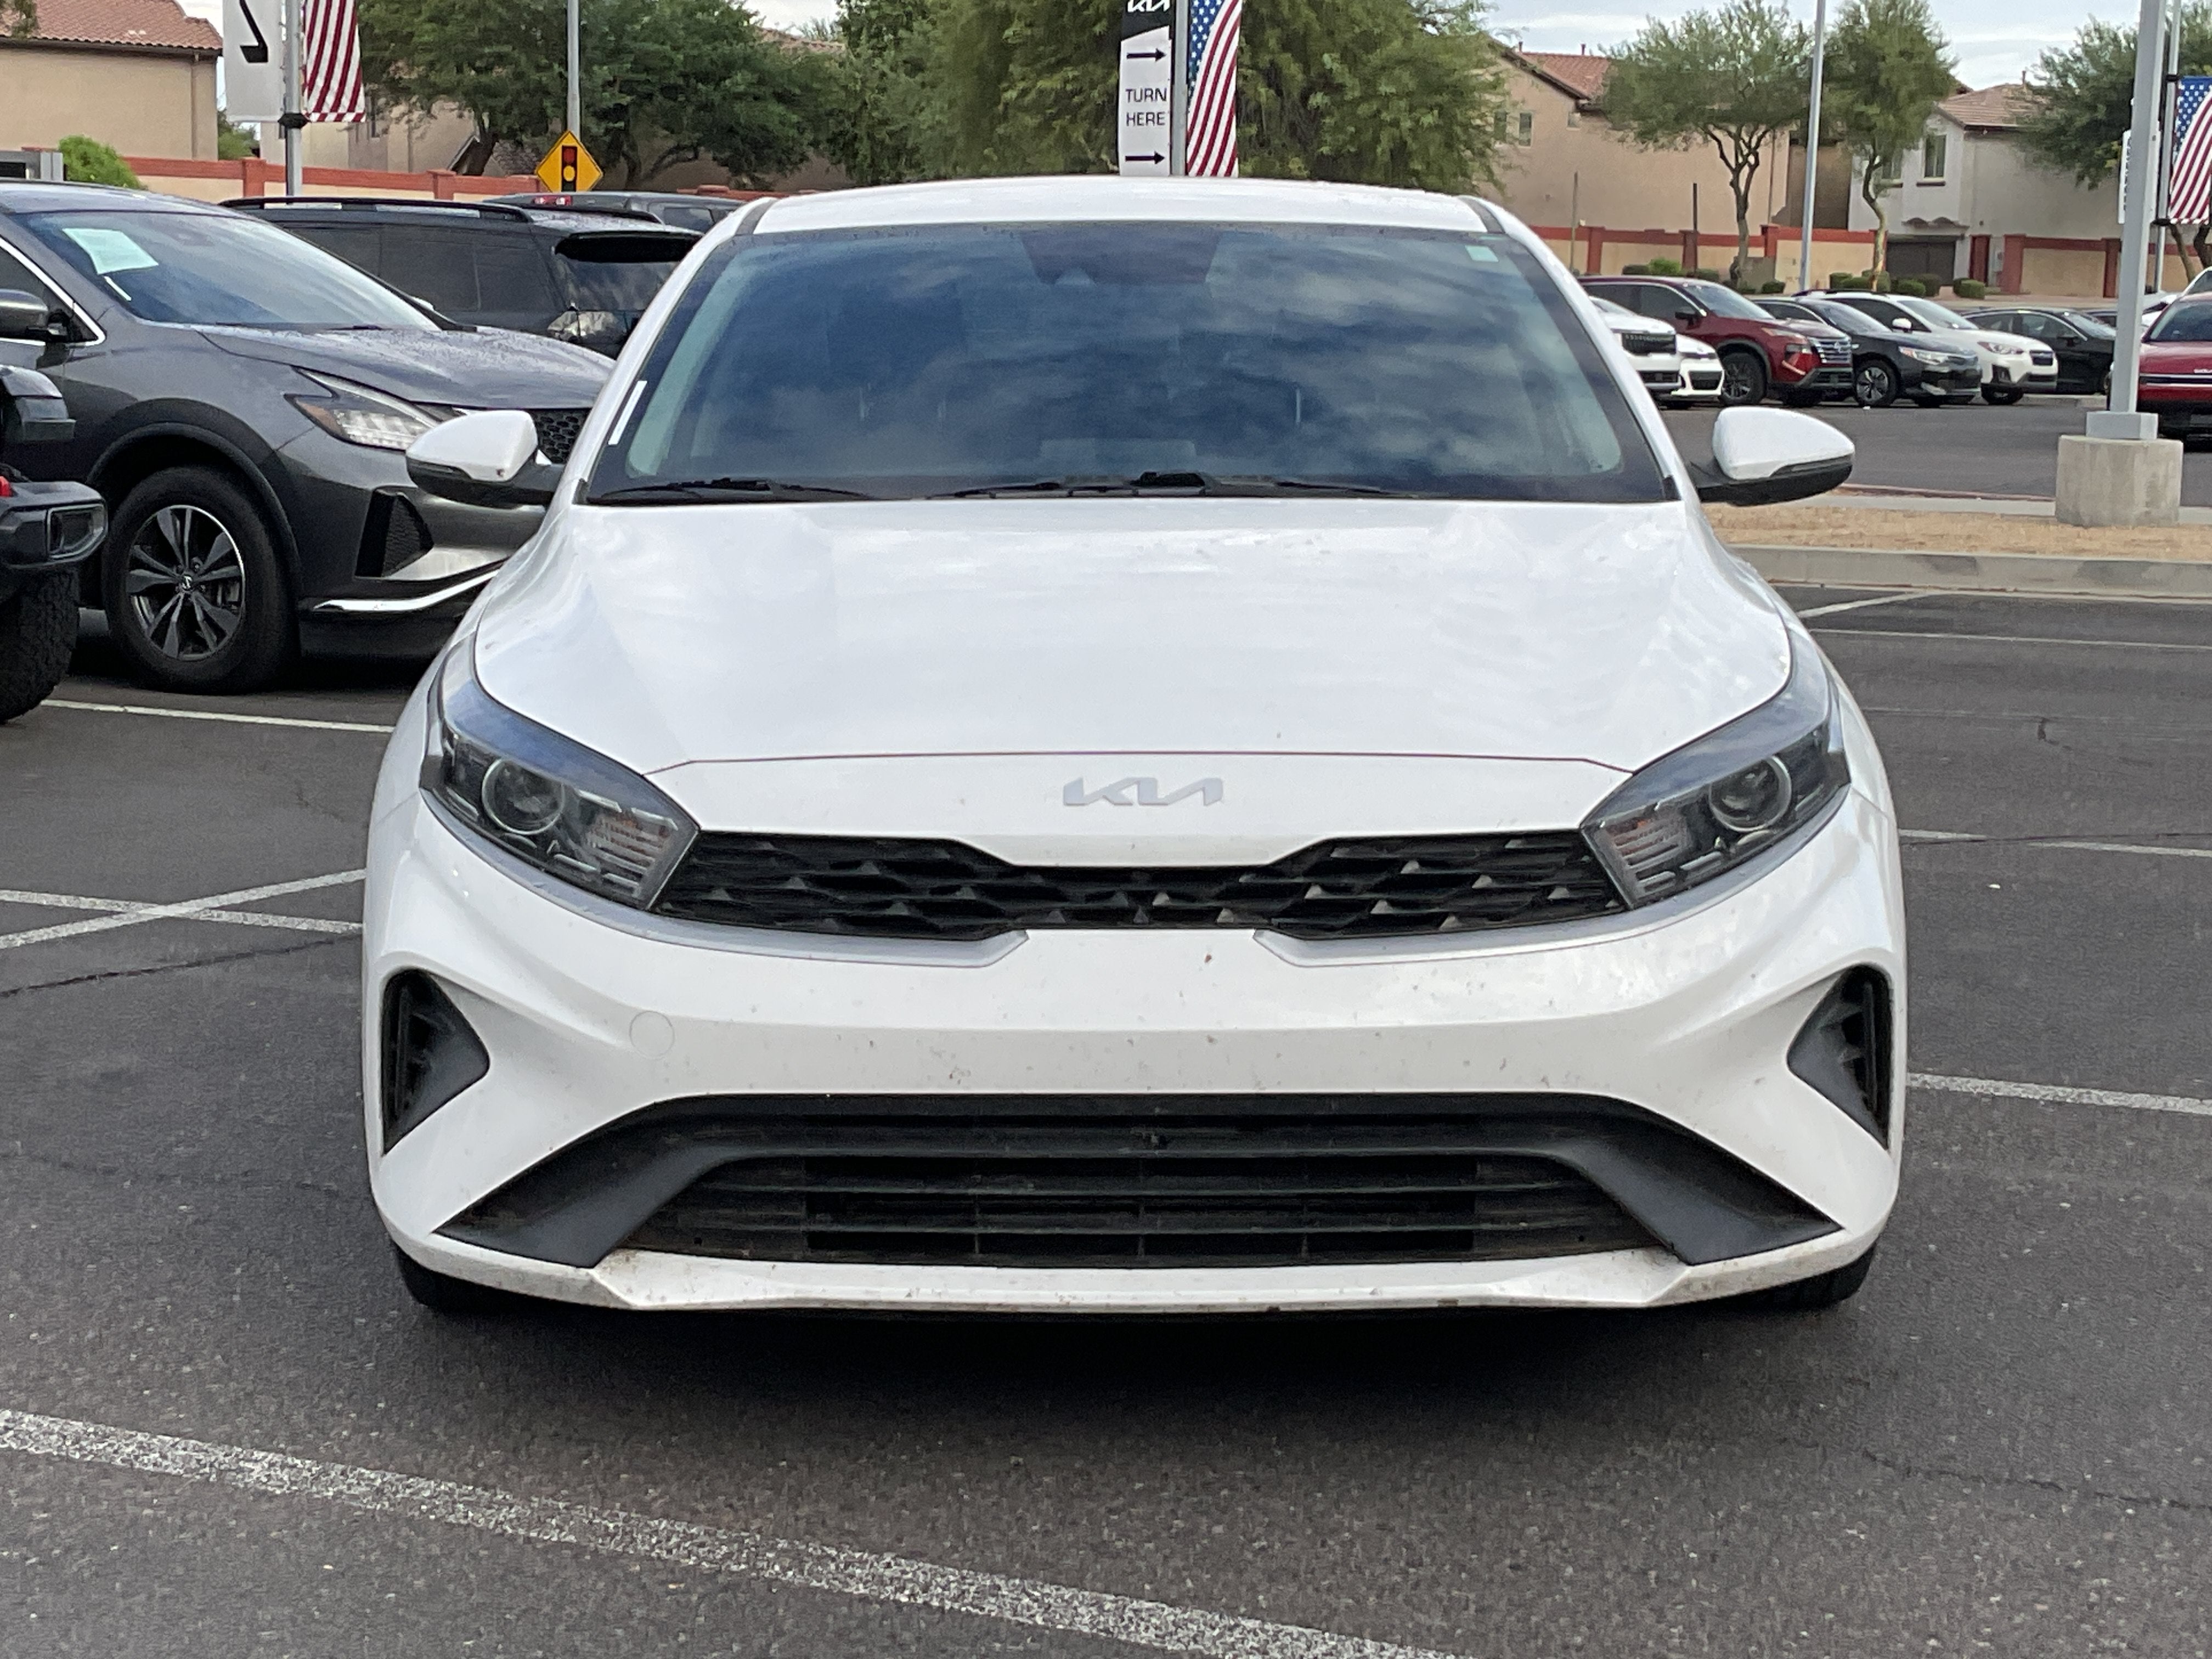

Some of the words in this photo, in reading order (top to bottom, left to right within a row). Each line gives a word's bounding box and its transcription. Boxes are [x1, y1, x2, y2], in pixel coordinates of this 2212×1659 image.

[1125, 87, 1167, 103] TURN
[1126, 111, 1166, 127] HERE
[1063, 777, 1223, 806] KIA
